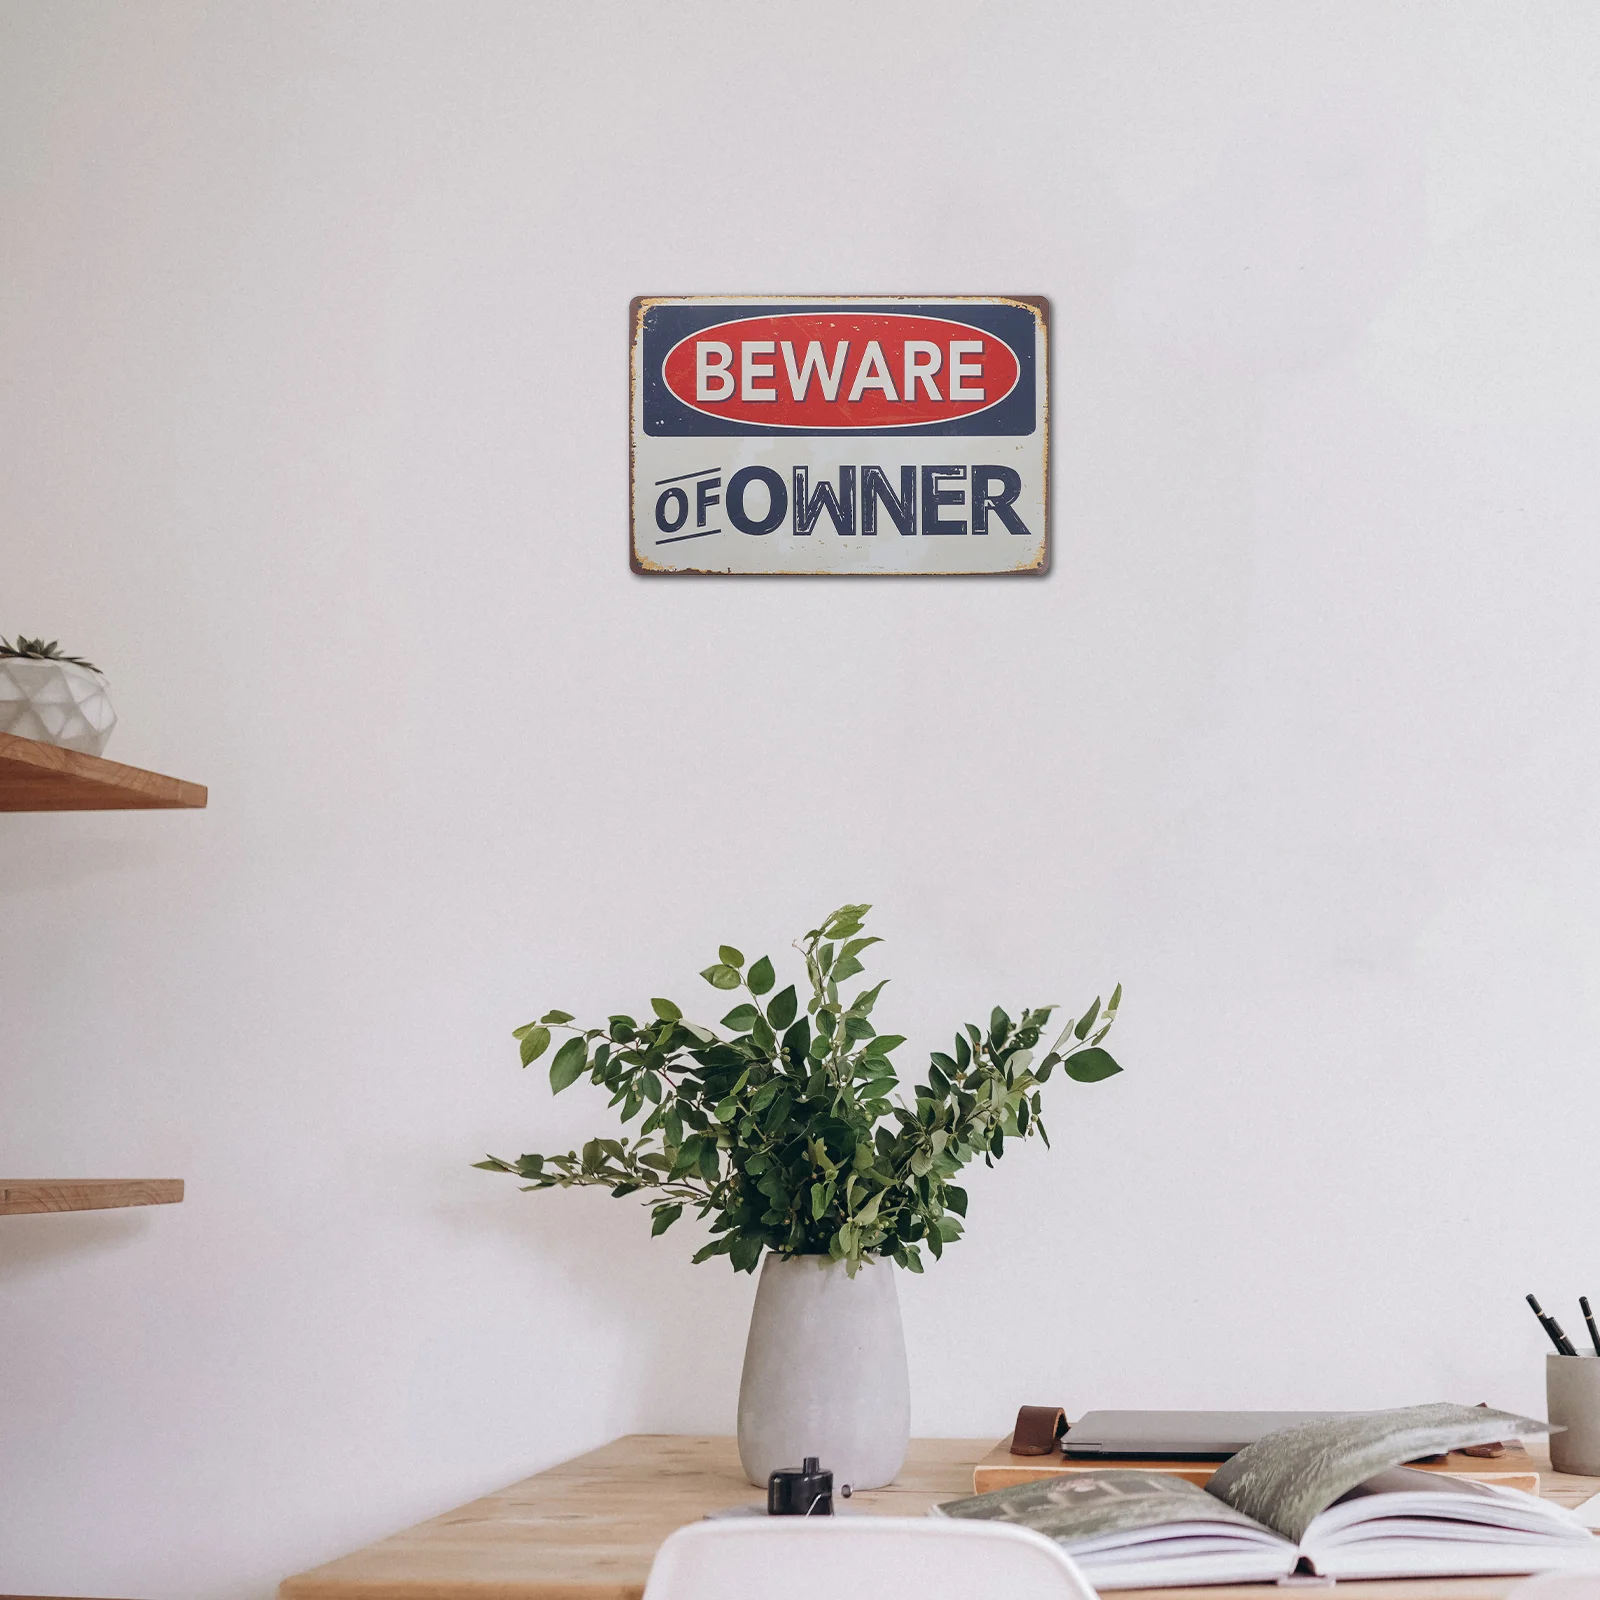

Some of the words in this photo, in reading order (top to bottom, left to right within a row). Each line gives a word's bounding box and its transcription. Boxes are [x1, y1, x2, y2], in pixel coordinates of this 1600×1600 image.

[695, 340, 985, 402] BEWARE
[655, 476, 722, 534] OF
[725, 465, 1032, 536] OWNER
